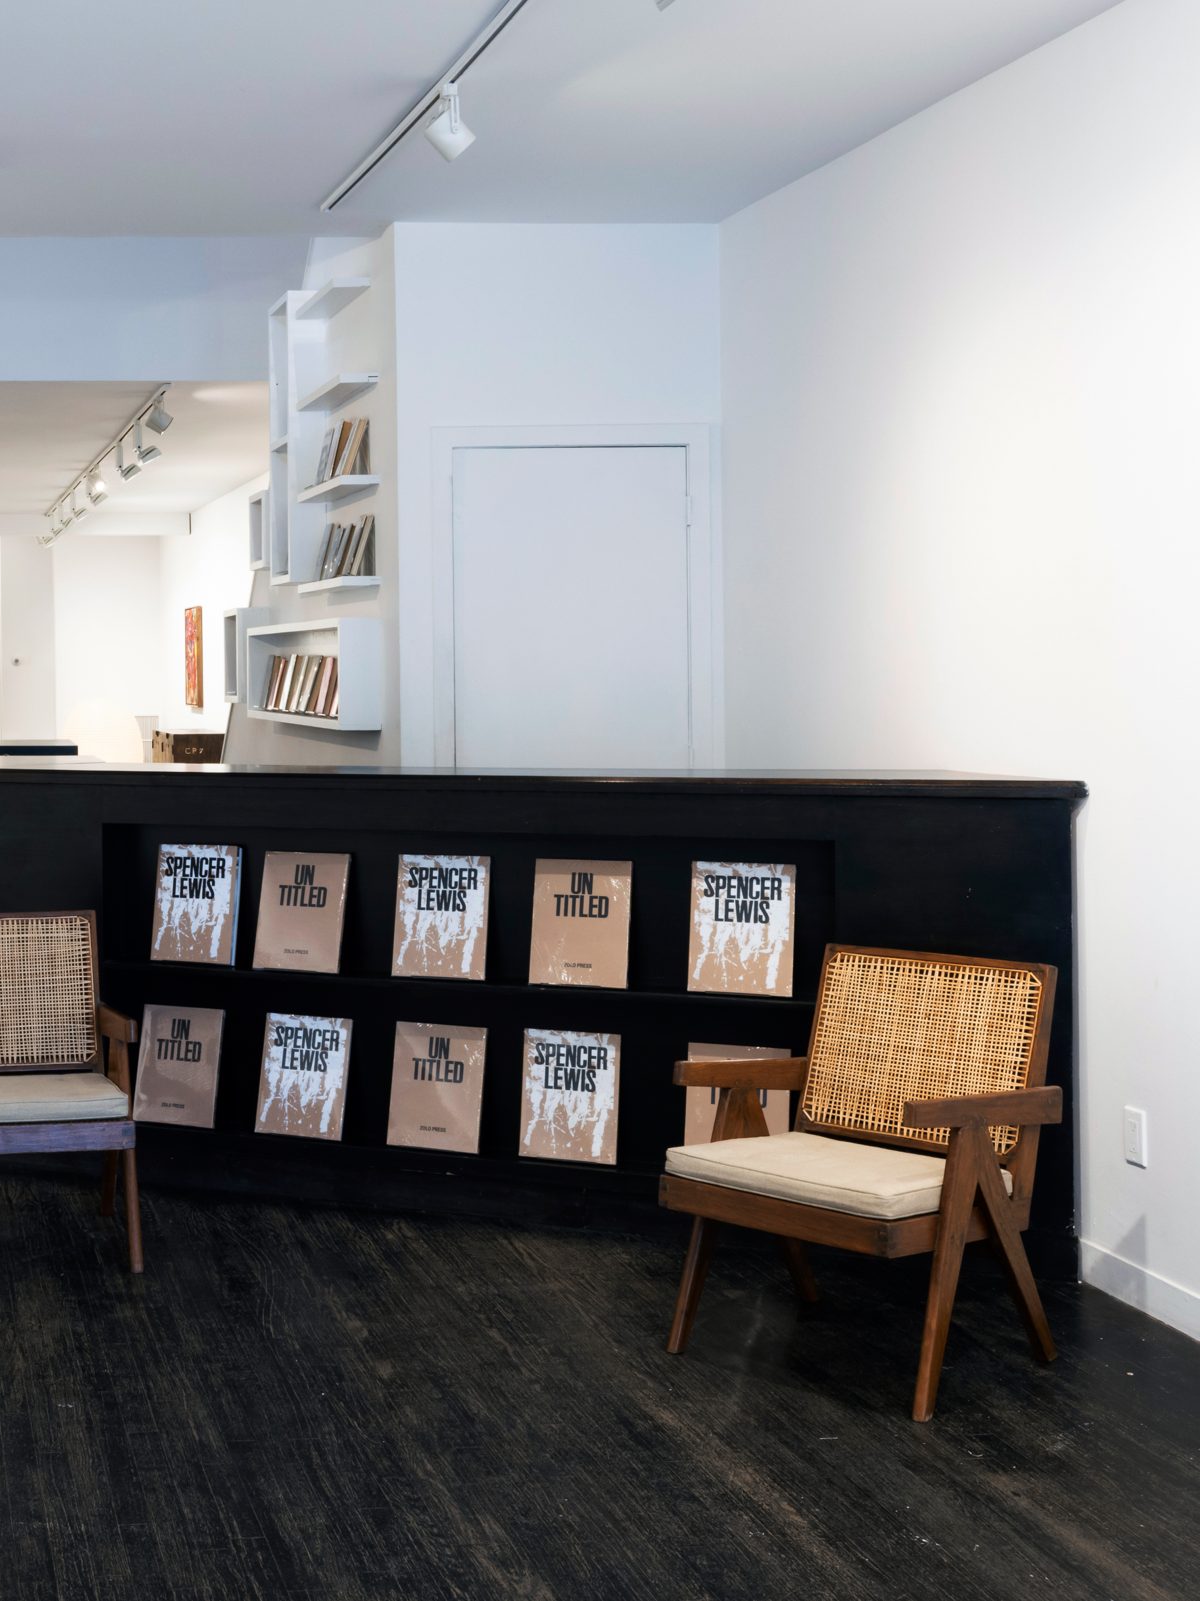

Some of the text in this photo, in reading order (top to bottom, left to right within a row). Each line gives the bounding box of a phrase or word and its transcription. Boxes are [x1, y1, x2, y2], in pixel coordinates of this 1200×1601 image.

[165, 856, 226, 879] SPENCER
[294, 864, 315, 886] UN
[408, 866, 478, 890] SPENCER
[171, 878, 216, 900] LEWIS
[570, 872, 593, 895] UN
[703, 875, 782, 901] SPENCER
[279, 884, 328, 908] TITLED
[417, 889, 467, 912] LEWIS
[554, 894, 609, 918] TITLED
[714, 899, 770, 924] LEWIS
[171, 1018, 191, 1040] UN
[274, 1025, 340, 1052] SPENCER
[156, 1039, 202, 1063] TITLED
[428, 1036, 450, 1060] UN
[534, 1042, 608, 1070] SPENCER
[281, 1048, 329, 1073] LEWIS
[412, 1057, 465, 1084] TITLED
[544, 1066, 596, 1093] LEWIS
